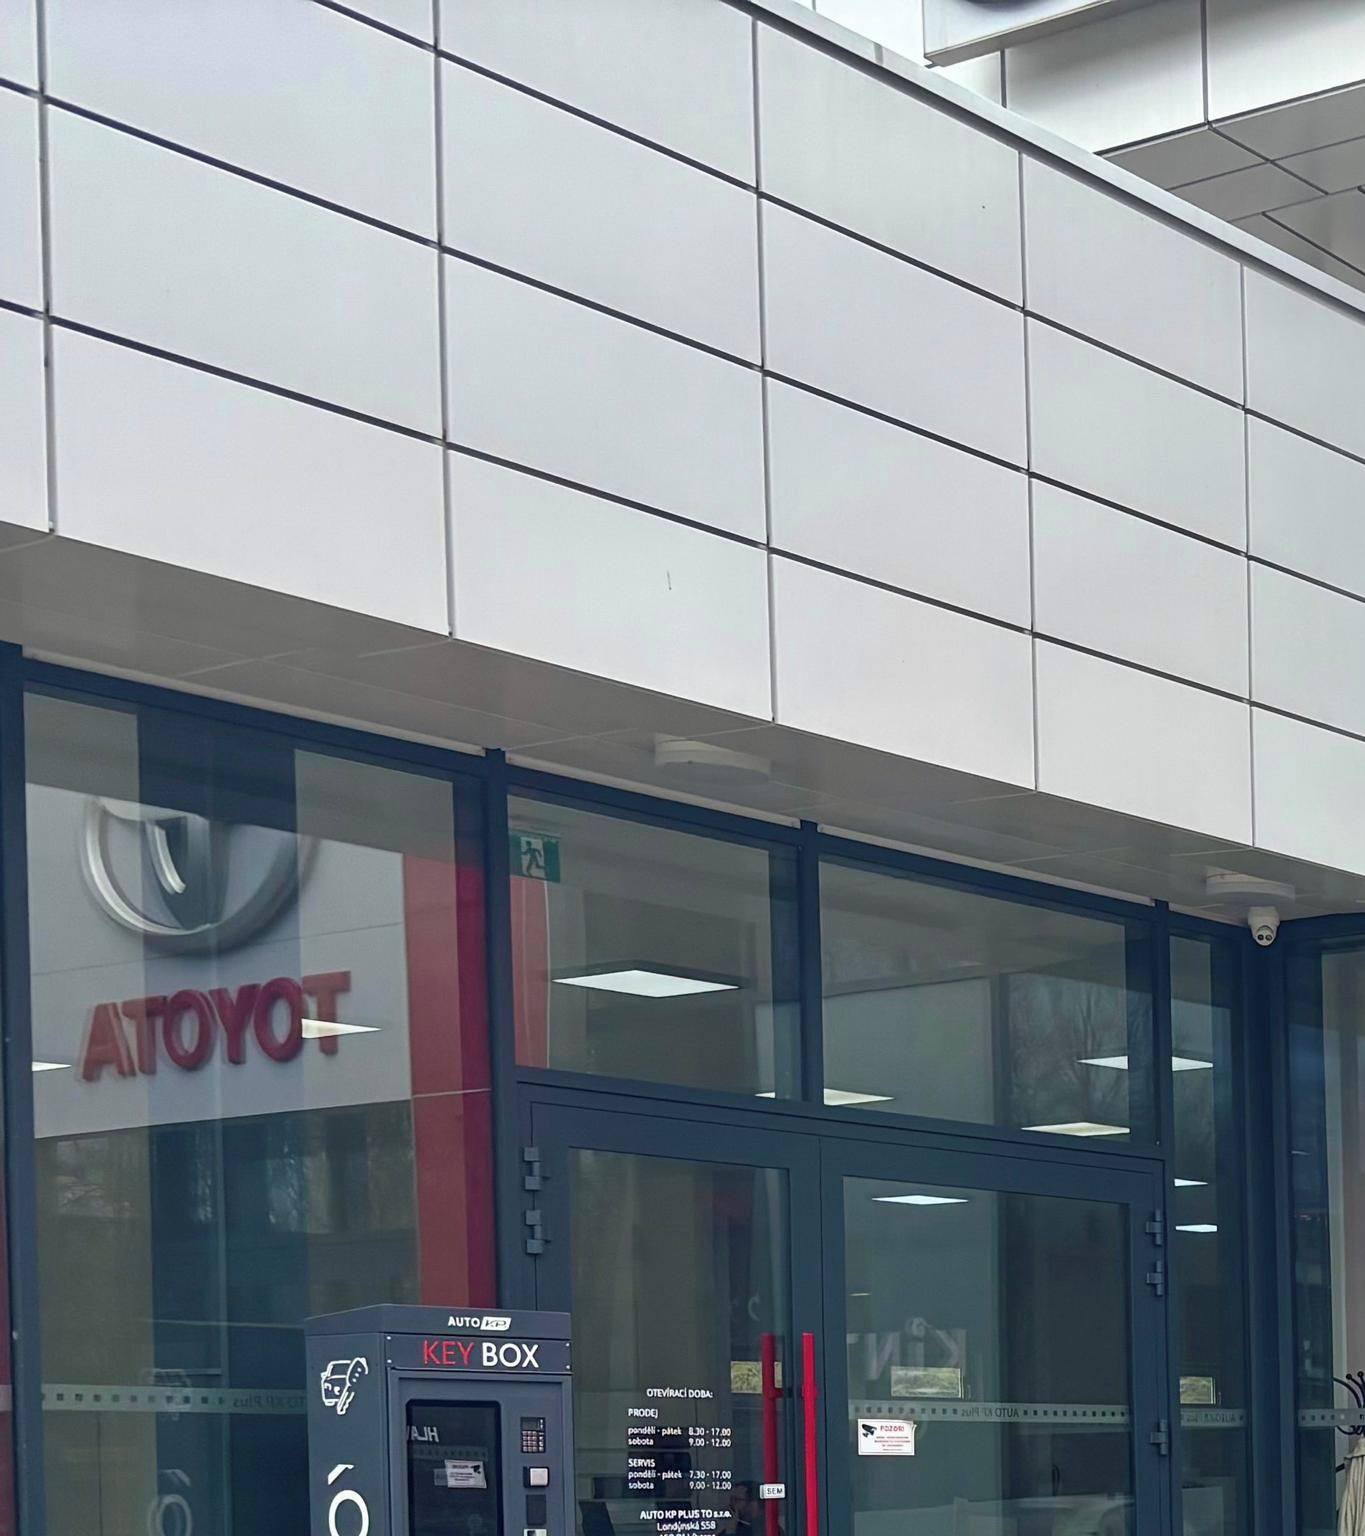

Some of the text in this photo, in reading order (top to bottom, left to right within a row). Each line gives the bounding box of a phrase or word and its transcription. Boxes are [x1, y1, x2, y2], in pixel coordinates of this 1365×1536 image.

[448, 1316, 480, 1328] AUTO
[423, 1340, 539, 1368] KEY BOX
[646, 1387, 713, 1398] OTEVÍRACÍ DOBA:
[627, 1408, 658, 1419] PRODEJ
[688, 1427, 705, 1436] 8.30
[711, 1428, 731, 1436] 17.00
[628, 1437, 654, 1445] sobota
[688, 1438, 705, 1446] 9.00
[711, 1438, 731, 1447] 12.00
[628, 1458, 656, 1467] SERVIS
[689, 1470, 705, 1479] 7.30
[712, 1471, 731, 1479] 17.00
[628, 1480, 654, 1489] sobota
[689, 1481, 705, 1490] 9.00
[712, 1481, 731, 1490] 12.00
[640, 1510, 664, 1519] AUTO
[665, 1510, 677, 1519] KP
[678, 1510, 700, 1518] PLUS
[701, 1510, 712, 1518] TO
[657, 1521, 699, 1532] Londýnská
